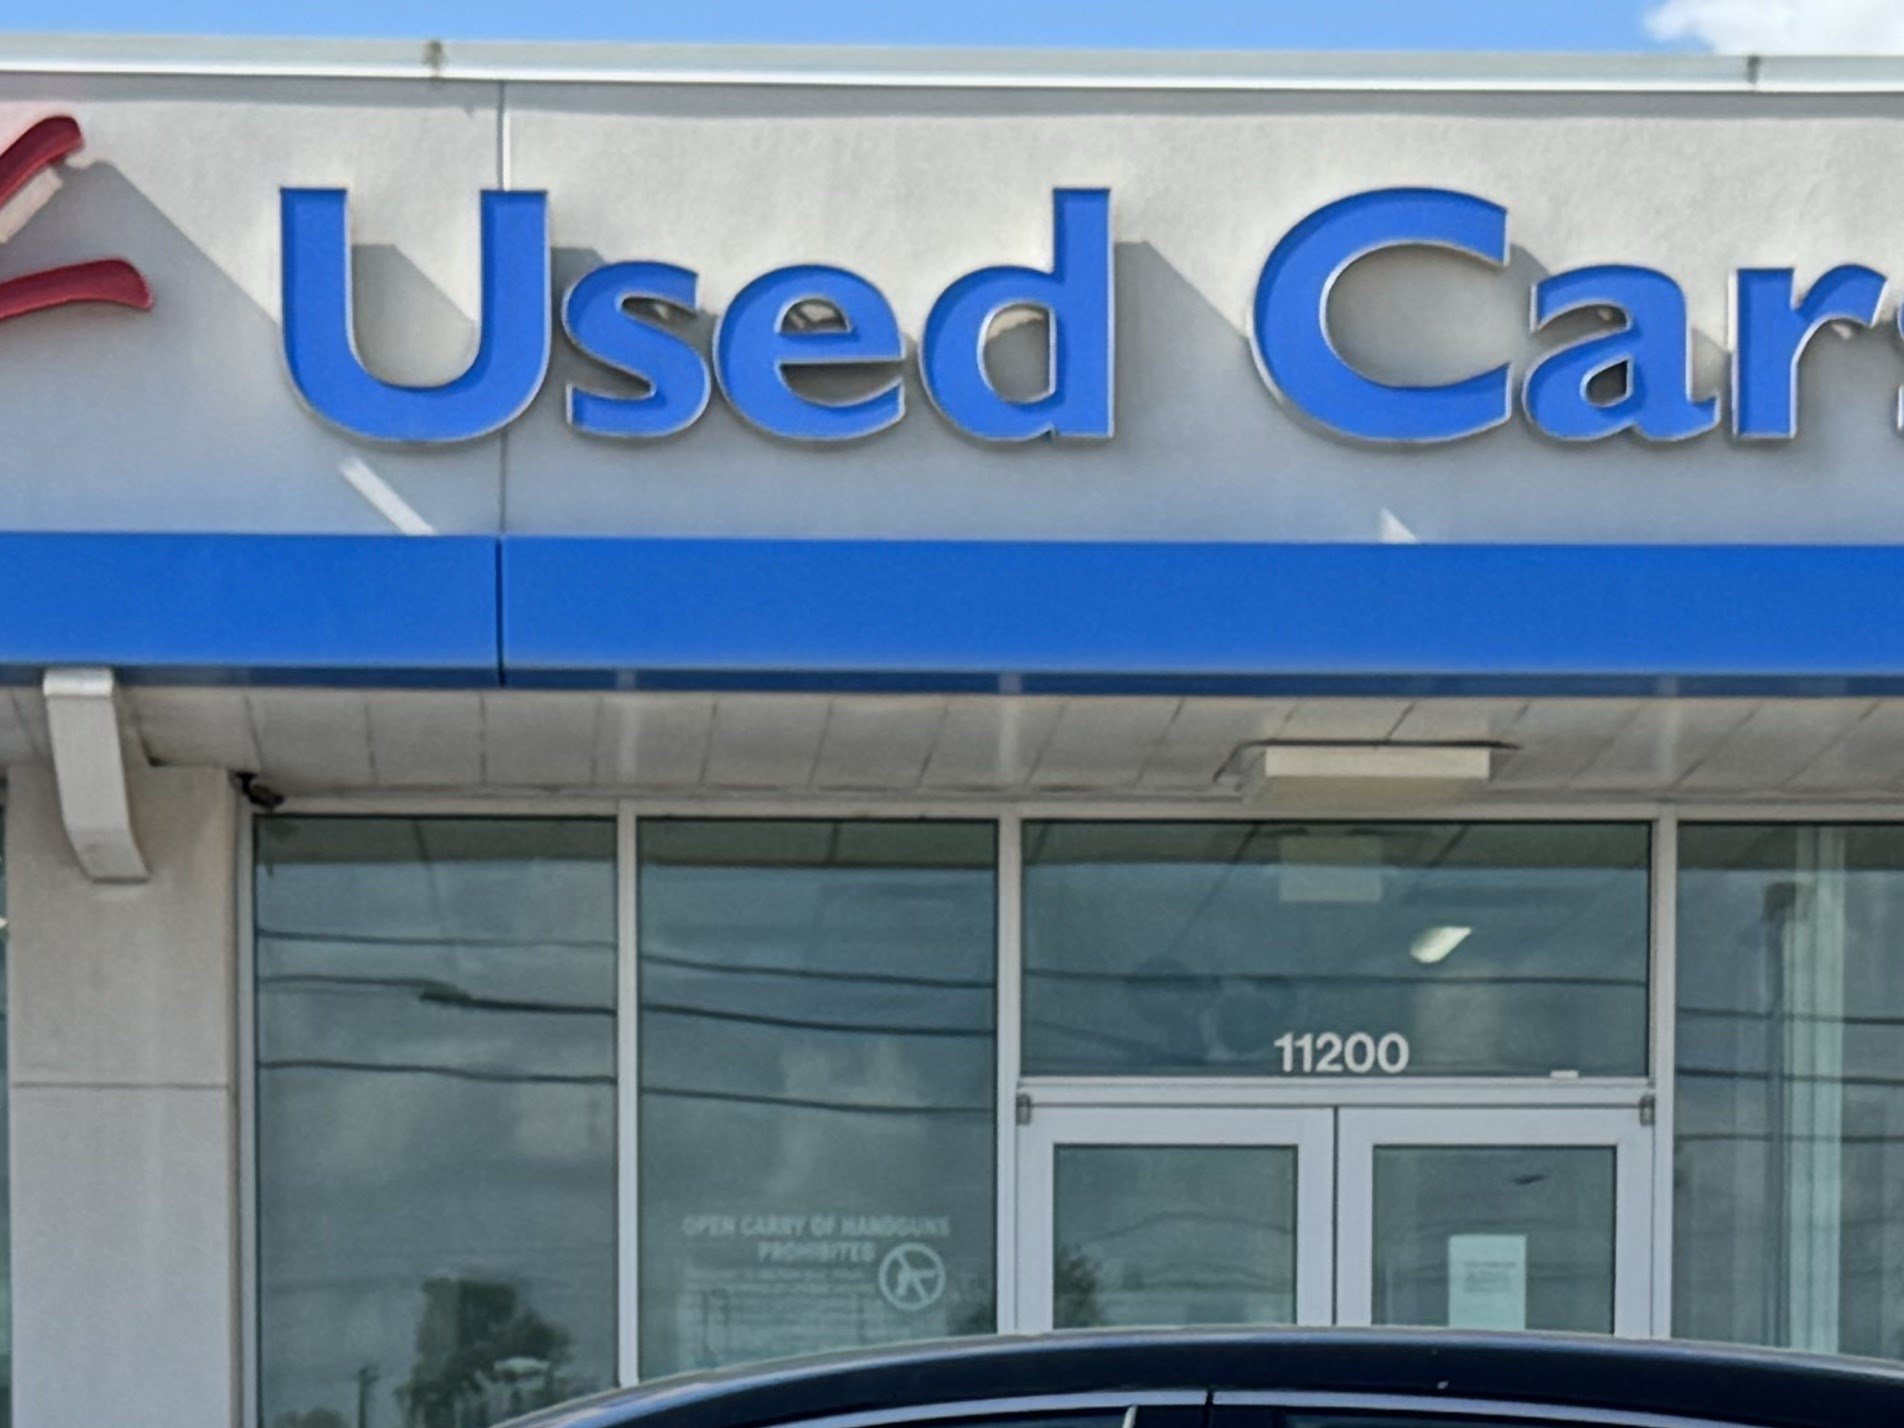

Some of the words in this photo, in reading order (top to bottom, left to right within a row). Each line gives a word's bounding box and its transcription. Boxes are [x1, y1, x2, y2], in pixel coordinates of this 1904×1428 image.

[278, 188, 1115, 442] Used
[1274, 1031, 1409, 1074] 11200
[682, 1214, 736, 1237] OPEN
[740, 1214, 806, 1237] CARRY
[809, 1214, 836, 1237] OF
